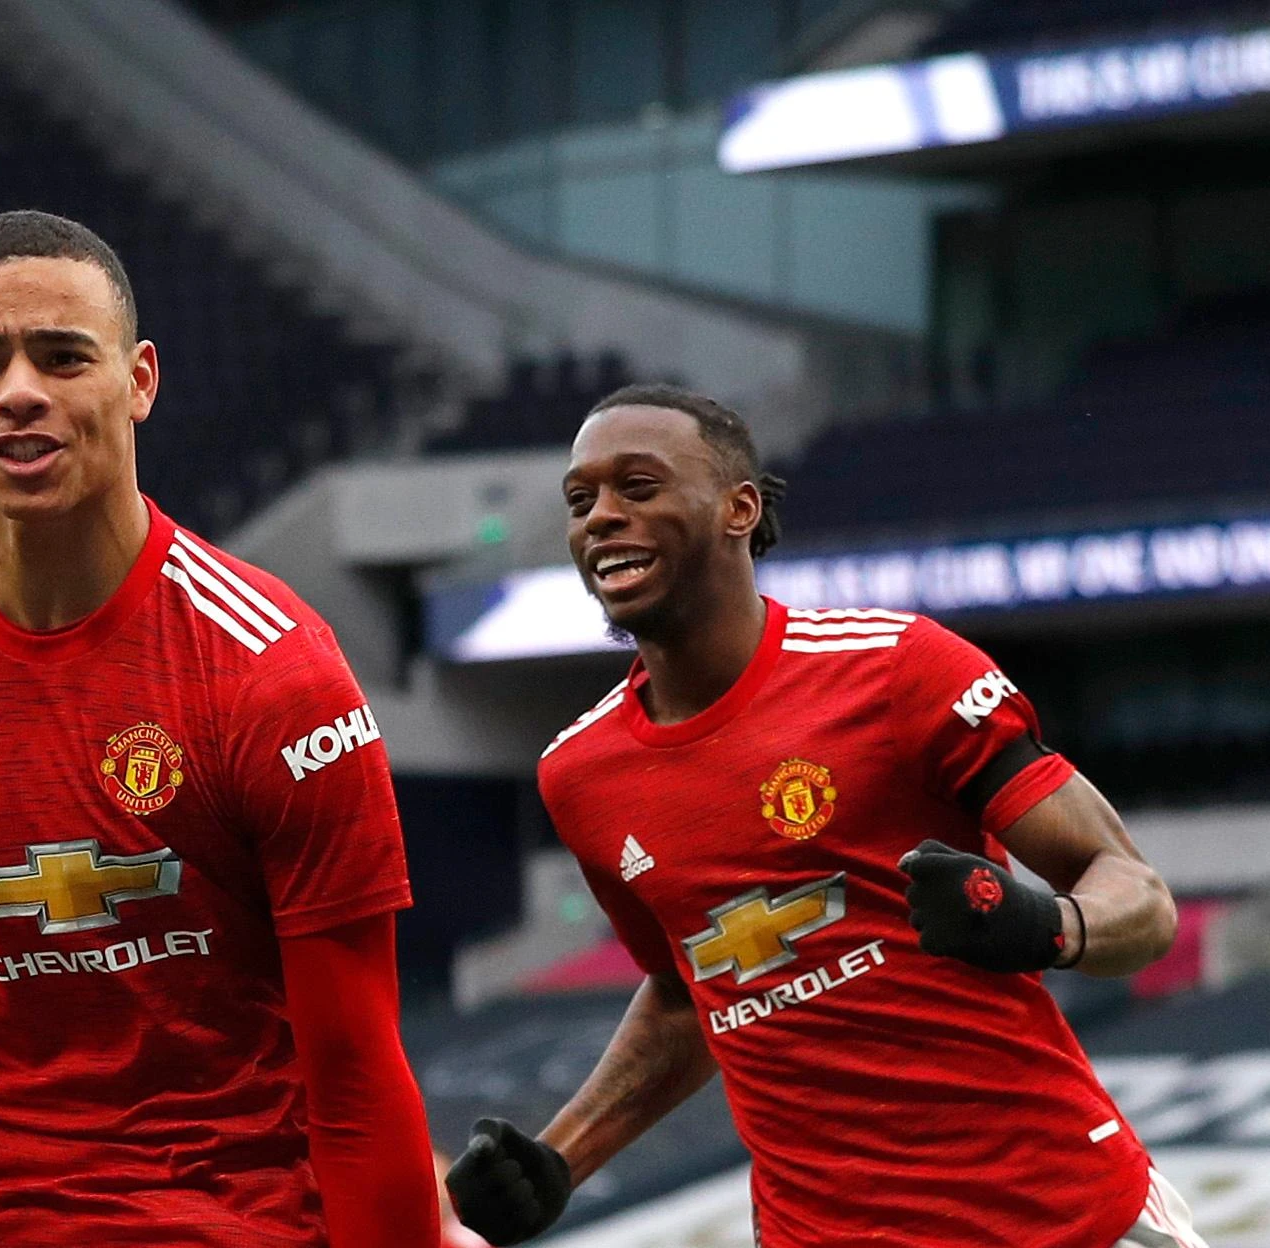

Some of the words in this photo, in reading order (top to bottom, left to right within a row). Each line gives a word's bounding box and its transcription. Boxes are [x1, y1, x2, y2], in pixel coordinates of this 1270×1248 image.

[112, 728, 178, 764] MANCHESTER
[116, 789, 164, 809] UNITED
[709, 938, 886, 1035] CHEVROLET
